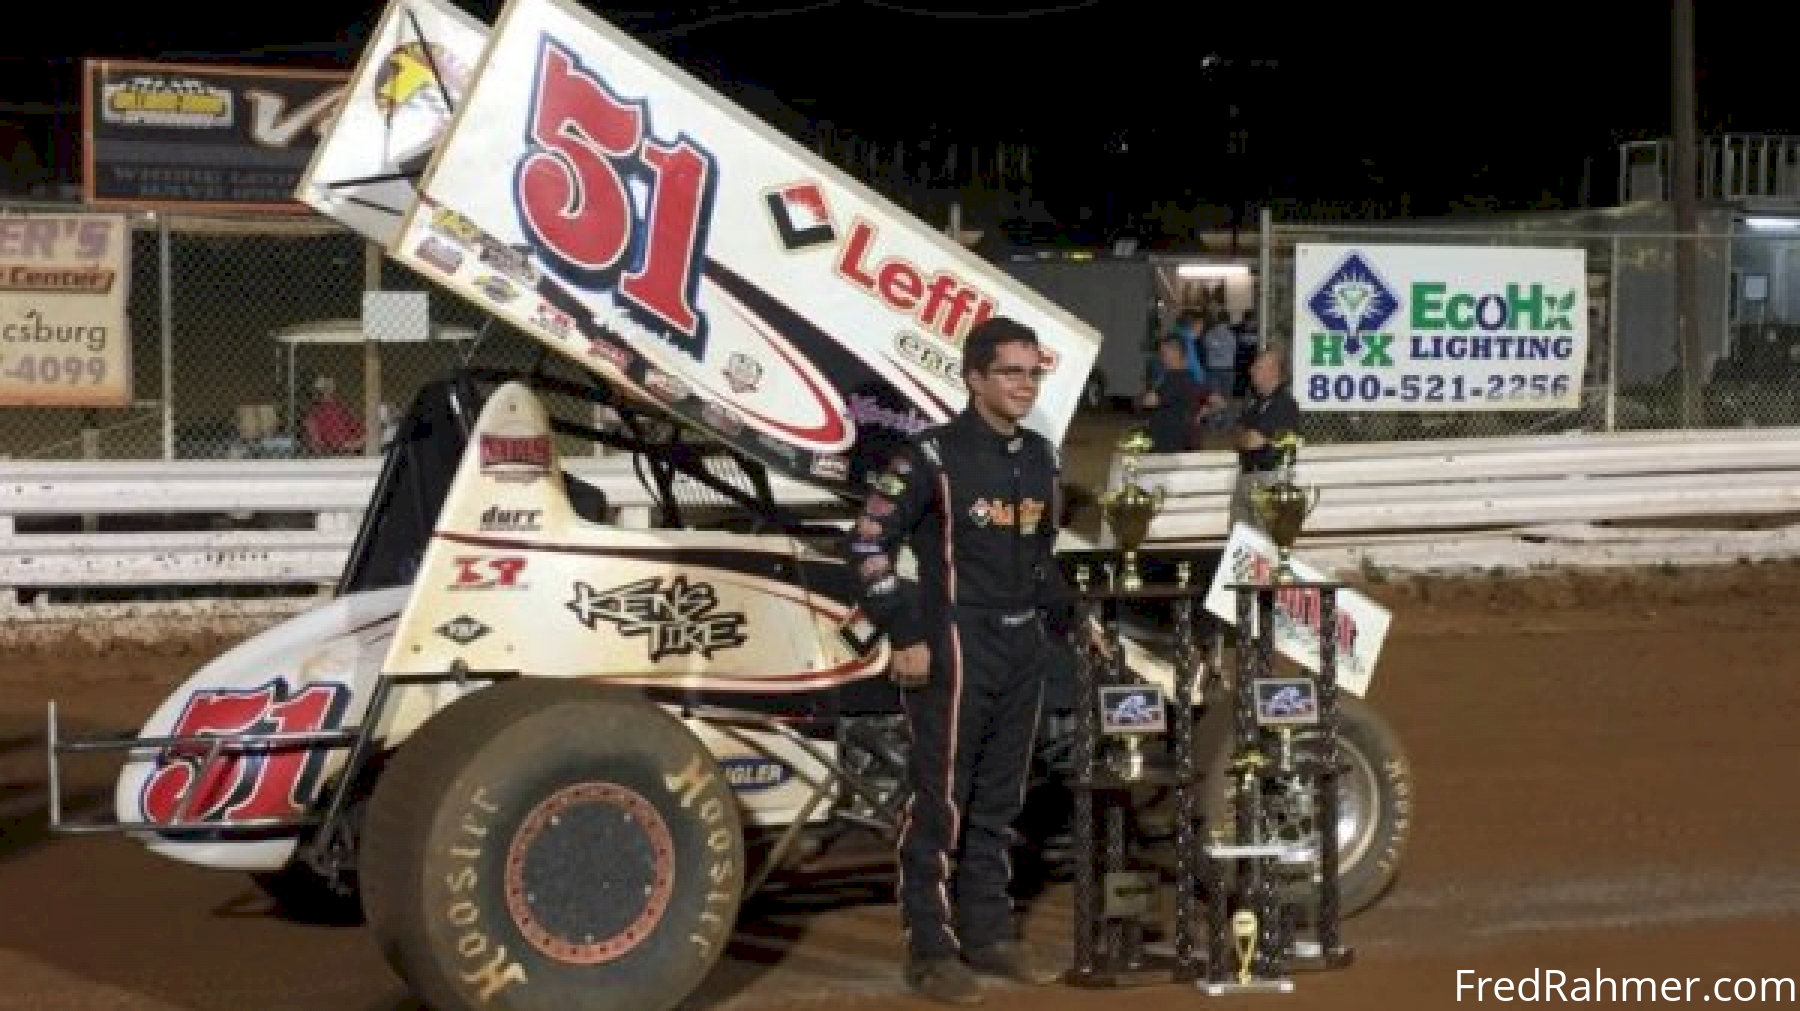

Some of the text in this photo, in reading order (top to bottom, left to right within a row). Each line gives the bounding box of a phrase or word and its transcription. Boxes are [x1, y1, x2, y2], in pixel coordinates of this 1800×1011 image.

[512, 30, 720, 364] 51
[1308, 374, 1571, 402] 800-521-2256
[1410, 337, 1573, 361] LIGHTING
[141, 677, 350, 838] 51
